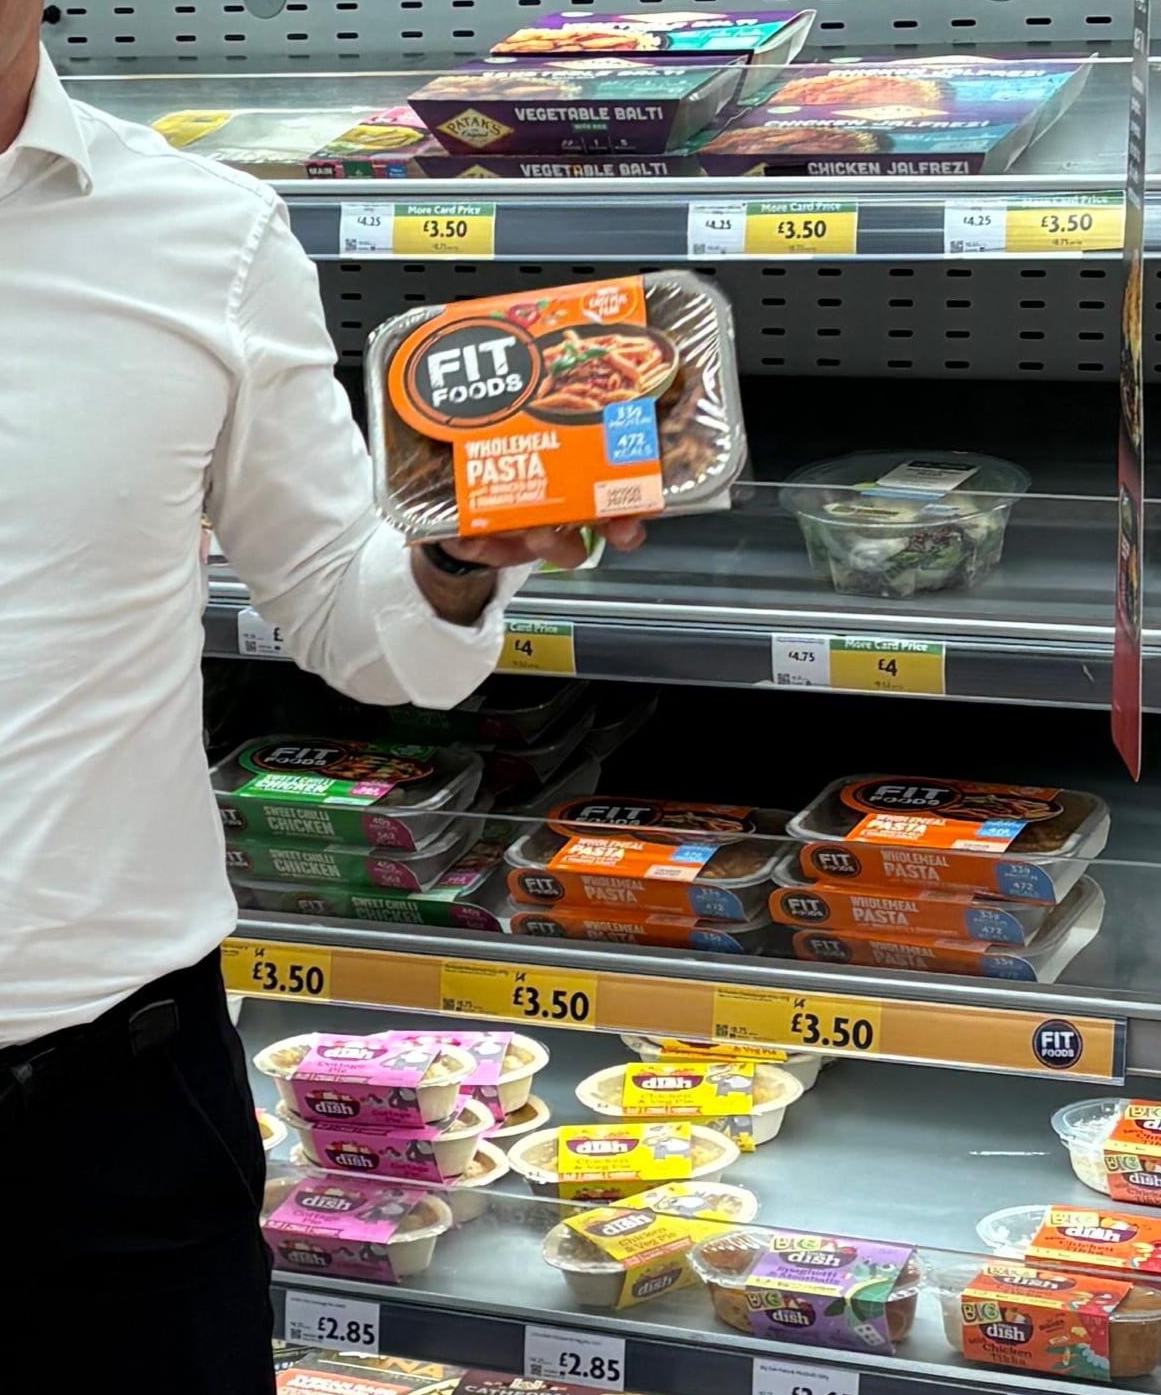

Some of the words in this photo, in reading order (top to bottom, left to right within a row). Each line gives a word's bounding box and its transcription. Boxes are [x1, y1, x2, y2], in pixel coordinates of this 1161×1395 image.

[514, 107, 610, 122] VEGETABLE
[615, 106, 663, 120] BALTI
[448, 118, 502, 136] PATAK'S
[520, 163, 616, 177] VEGETABLE
[619, 162, 668, 176] BALTI
[807, 161, 880, 176] CHICKEN
[885, 161, 970, 175] JALFREZI
[407, 205, 431, 215] More
[455, 205, 481, 216] Price
[423, 220, 468, 239] £3.50
[777, 220, 827, 240] £3.50
[1040, 213, 1092, 233] £3.50
[427, 337, 517, 389] FIT
[432, 374, 523, 407] FOODS
[464, 432, 560, 458] WHOLEMEAL
[466, 456, 545, 486] PASTA
[845, 638, 870, 649] More
[873, 640, 898, 650] Card
[901, 640, 928, 652] Price
[788, 649, 816, 663] £4.75
[272, 746, 339, 760] FIT
[870, 796, 940, 806] FOODS
[878, 785, 948, 800] FIT
[580, 806, 651, 819] FIT
[267, 817, 334, 836] CHICKEN
[818, 853, 851, 867] FIT
[880, 849, 948, 867] WHOLEMEAL
[272, 858, 341, 878] CHICKEN
[884, 862, 939, 881] PASTA
[581, 876, 645, 890] WHOLEMEAL
[585, 888, 637, 902] PASTA
[789, 898, 820, 912] FIT
[851, 896, 919, 913] WHOLEMEAL
[853, 908, 909, 926] PASTA
[252, 962, 324, 995] £3.50
[512, 985, 590, 1022] £3.50
[790, 1012, 874, 1050] £3.50
[1041, 1030, 1076, 1049] FIT
[1041, 1047, 1075, 1059] FOODS
[302, 1196, 352, 1211] dish
[603, 1214, 653, 1236] dish
[788, 1251, 840, 1266] dish
[772, 1310, 810, 1325] dish
[317, 1316, 375, 1345] £2.85
[987, 1326, 1026, 1342] dish
[982, 1342, 1032, 1358] Chicken
[559, 1352, 620, 1381] £2.85
